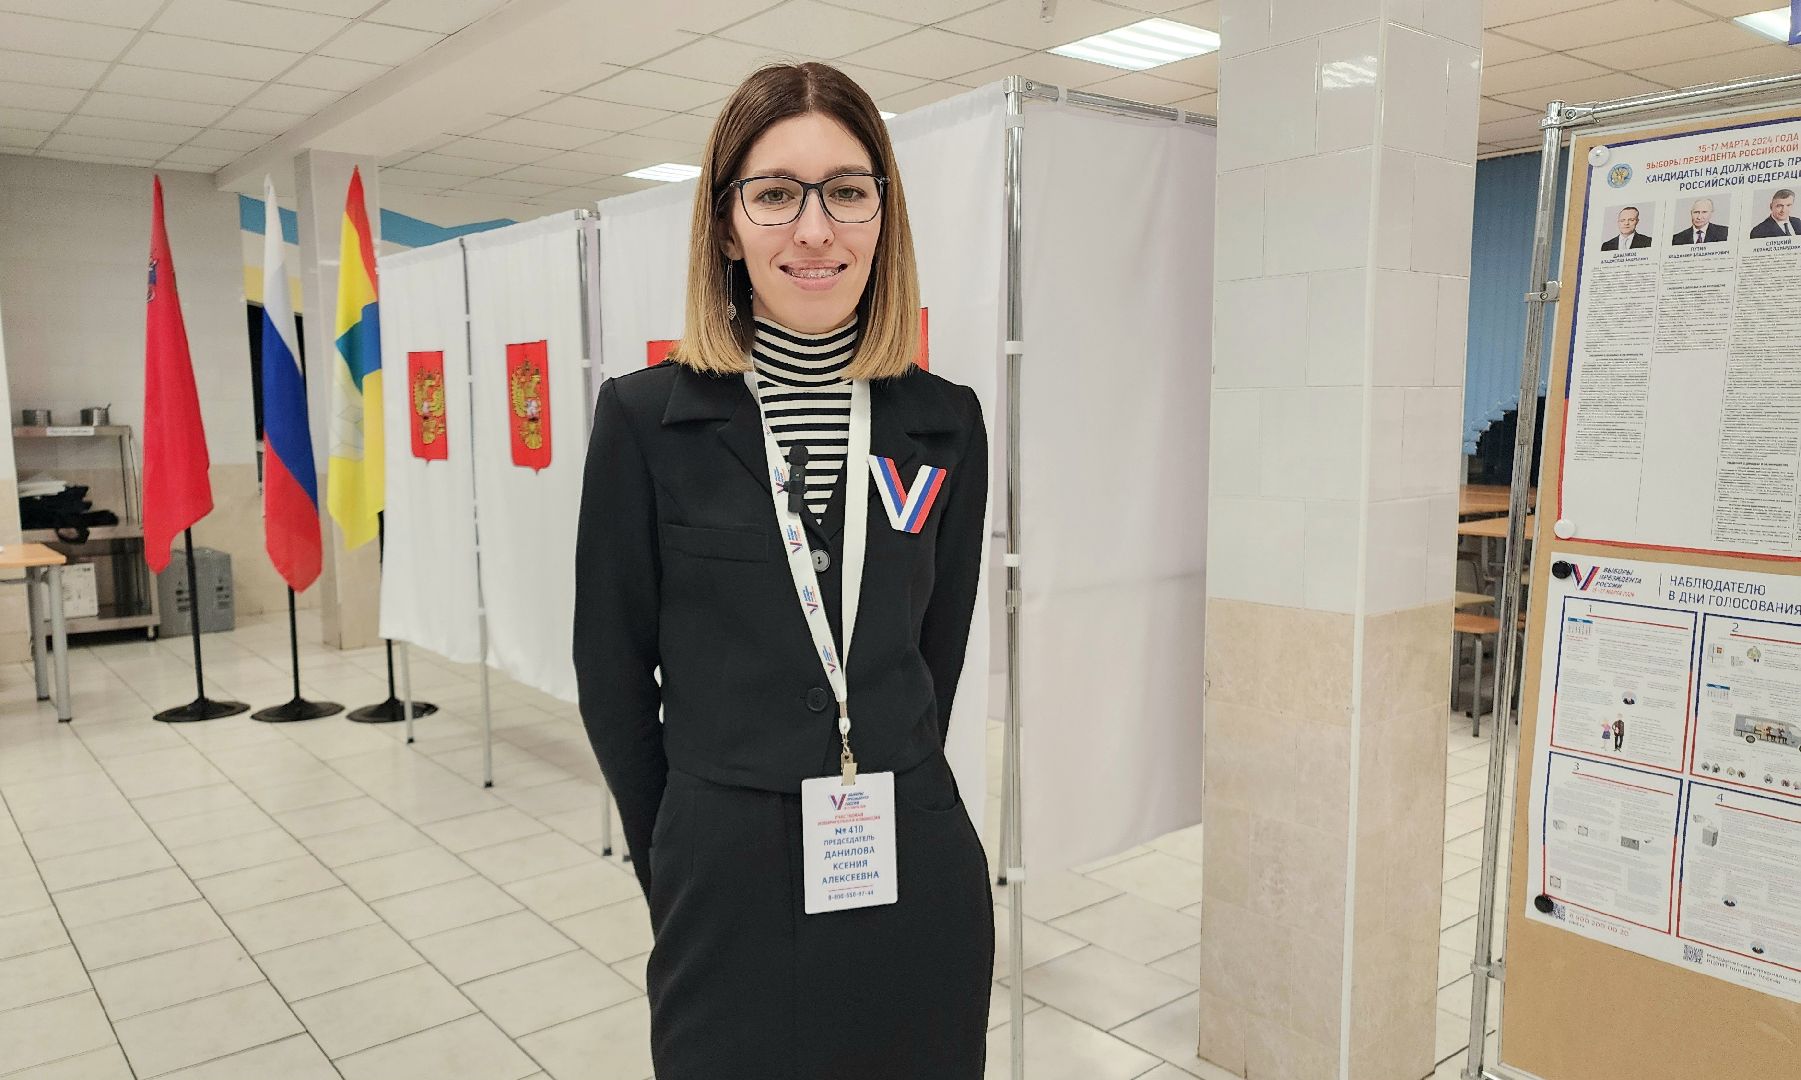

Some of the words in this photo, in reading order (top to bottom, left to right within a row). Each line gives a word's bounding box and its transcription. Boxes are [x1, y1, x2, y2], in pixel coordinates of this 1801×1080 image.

[1721, 139, 1750, 150] МАРТА
[1752, 136, 1773, 146] 2024
[1775, 132, 1799, 143] ГОДА
[1646, 158, 1681, 170] ВЫБОРЫ
[1683, 151, 1736, 165] ПРЕЗИДЕНТА
[1740, 143, 1799, 158] РОССИЙСКОЙ
[1645, 168, 1703, 183] КАНДИДАТЫ
[1705, 165, 1718, 177] НА
[1720, 158, 1785, 176] ДОЛЖНОСТЬ
[1679, 174, 1745, 192] РОССИЙСКОЙ
[1670, 575, 1766, 596] НАБЛЮДАТЕЛЮ
[1668, 591, 1676, 601] В
[1678, 592, 1705, 606] ДНИ
[1708, 595, 1801, 616] ГОЛОСОВАНИЯ
[1731, 622, 1739, 633] 2
[848, 825, 864, 834] 410
[823, 835, 875, 846] ПРЕДСЕДАТЕЛЬ
[824, 846, 875, 860] ДАНИЛОВА
[832, 859, 868, 871] КСЕНИЯ
[821, 870, 880, 885] АЛЕКСЕЕВНА
